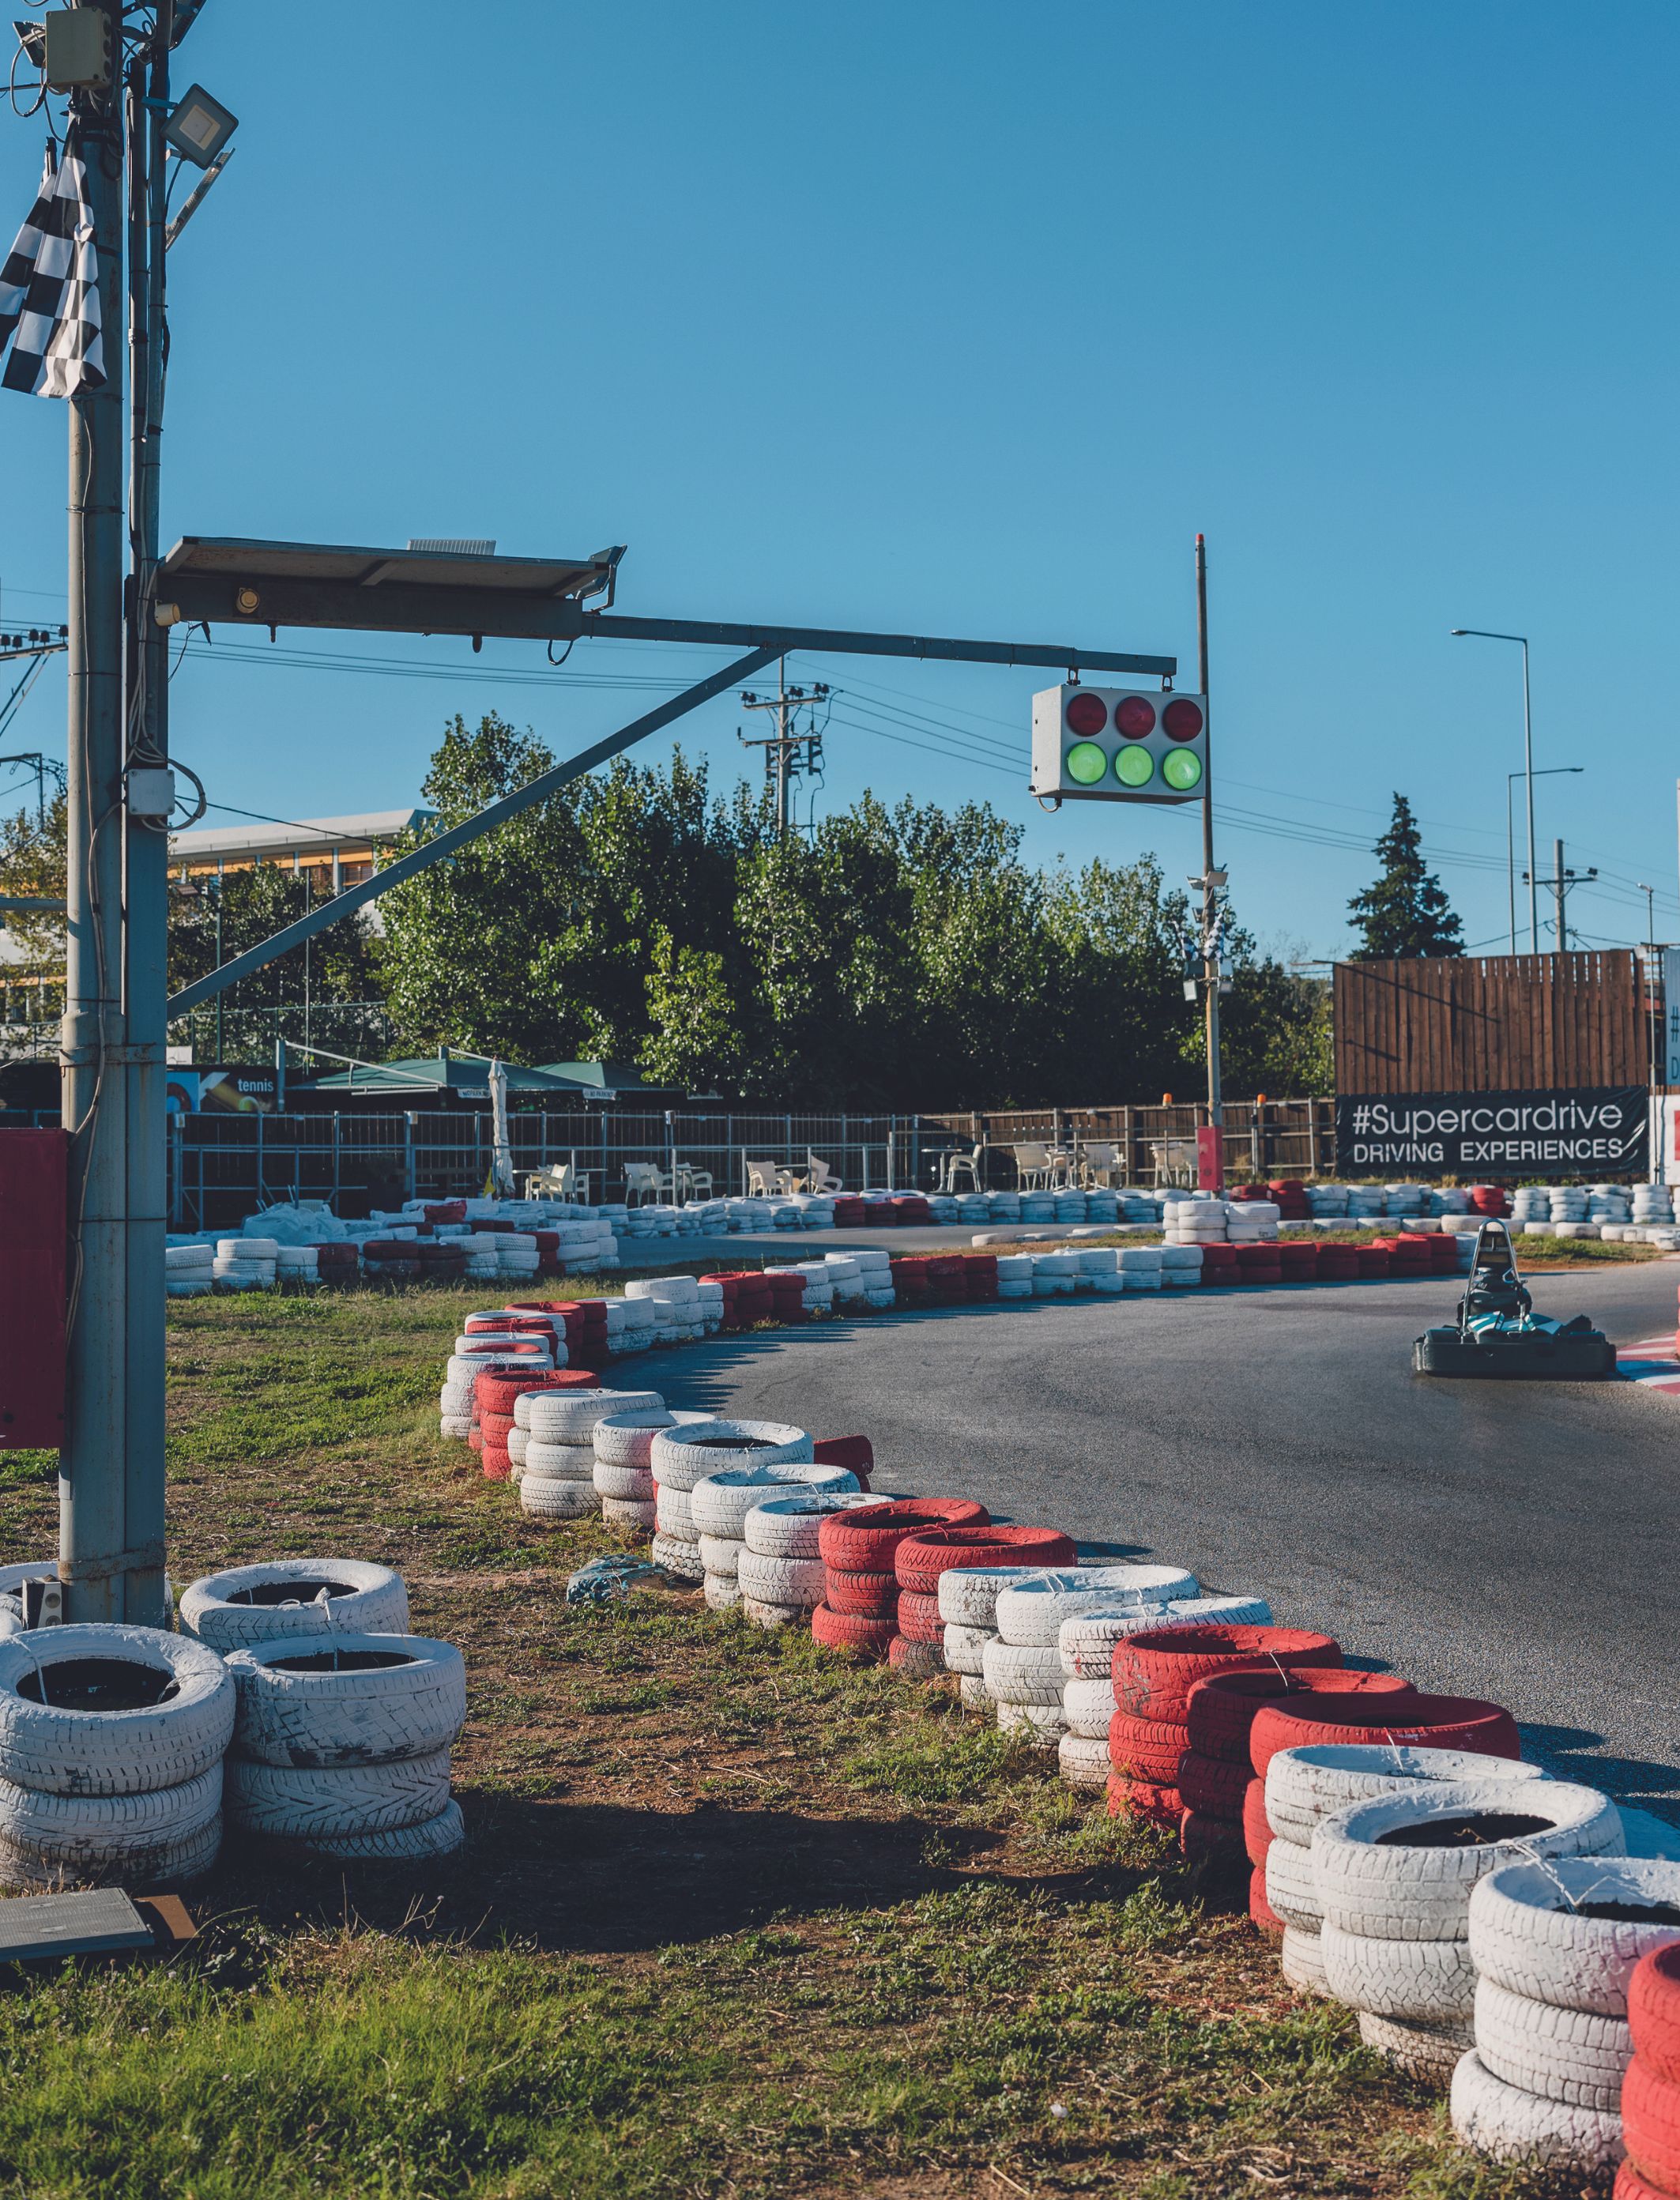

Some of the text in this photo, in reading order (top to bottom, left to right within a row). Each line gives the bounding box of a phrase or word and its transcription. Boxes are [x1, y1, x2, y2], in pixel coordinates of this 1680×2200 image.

[238, 1078, 274, 1092] tennis
[1353, 1099, 1622, 1141] #Supercardrive
[1354, 1138, 1622, 1163] DRIVING EXPERIENCES
